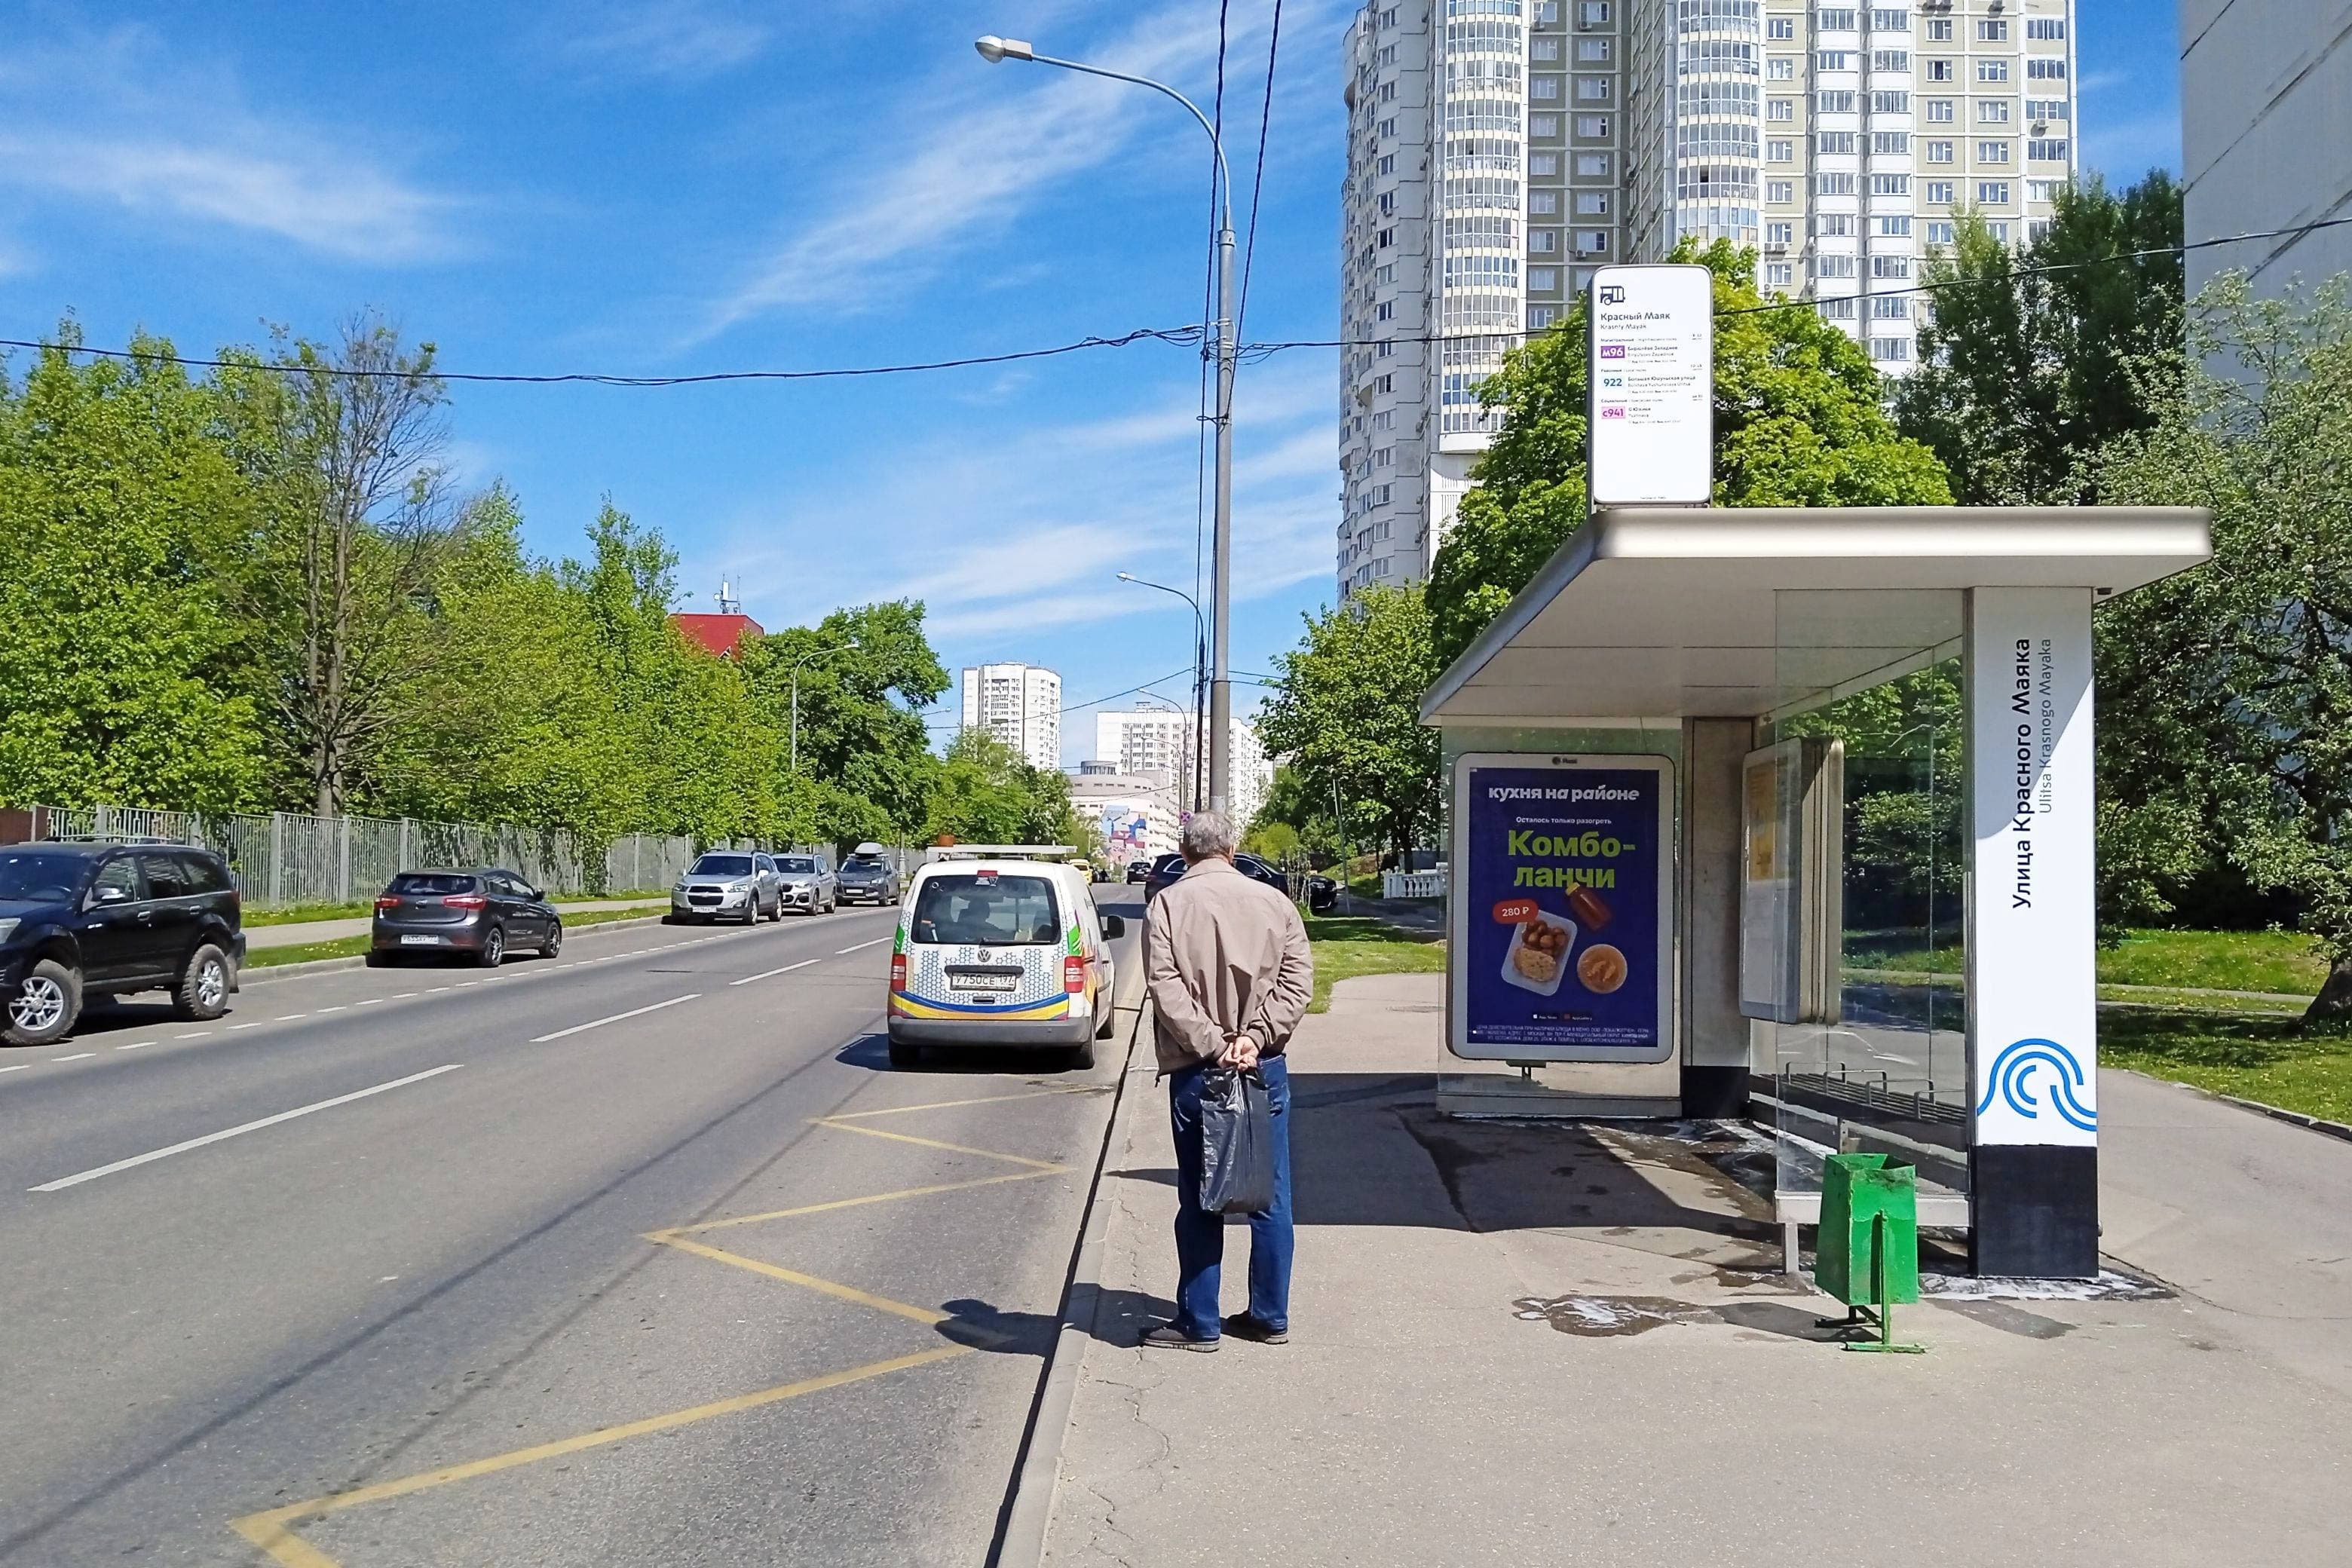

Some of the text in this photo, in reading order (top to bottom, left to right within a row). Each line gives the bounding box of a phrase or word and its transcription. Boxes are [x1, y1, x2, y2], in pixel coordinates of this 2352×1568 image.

[1600, 313, 1642, 322] Красный
[1603, 378, 1622, 387] 922
[2038, 639, 2054, 813] Ulitsa Krasnogo Mayaka
[2011, 639, 2035, 908] Улица Красного Маяка
[1488, 785, 1640, 802] кухня на районе
[1508, 830, 1636, 857] Комбо-
[1514, 867, 1615, 888] ланчи
[1502, 908, 1521, 917] 280
